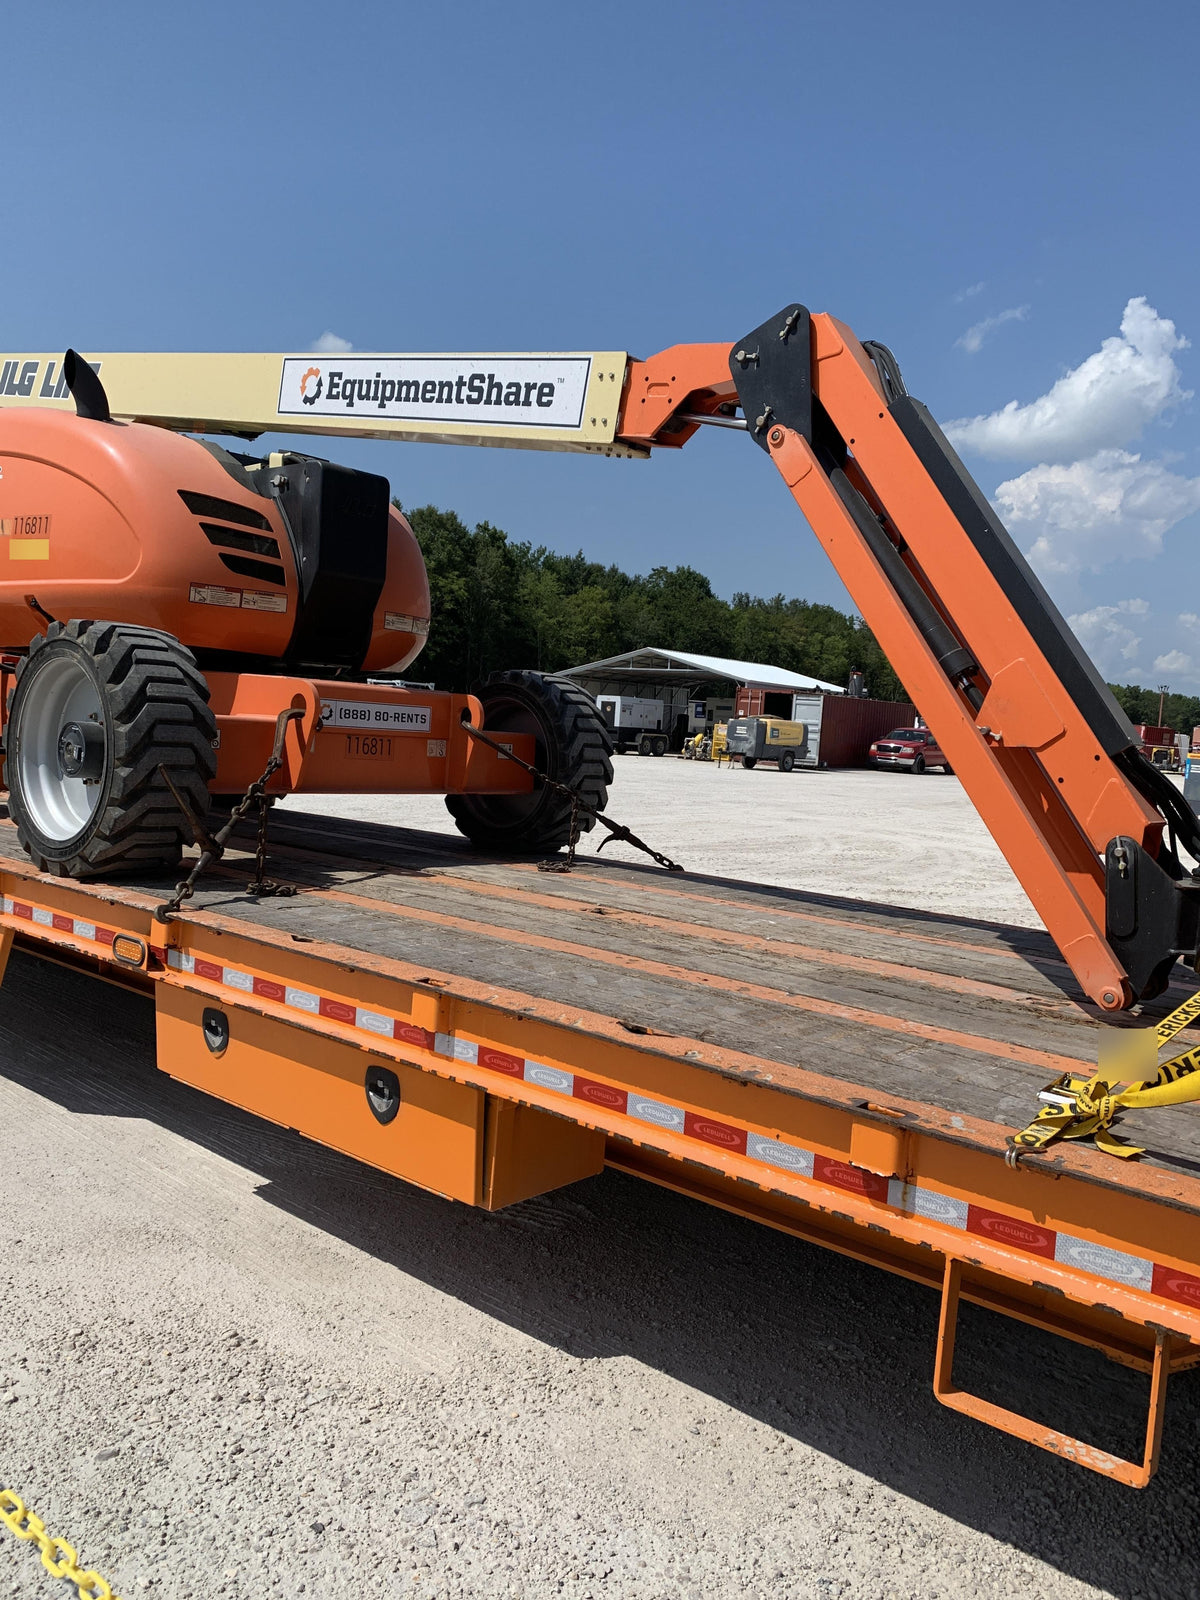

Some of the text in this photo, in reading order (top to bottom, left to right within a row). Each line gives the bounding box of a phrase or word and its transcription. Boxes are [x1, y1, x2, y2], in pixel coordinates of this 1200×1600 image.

[325, 371, 556, 409] EquipmentShare
[14, 516, 49, 535] 116811
[339, 707, 428, 725] (888) 80-RENTS
[346, 735, 392, 756] 116811
[1158, 994, 1200, 1038] ERICKSO
[590, 1088, 616, 1102] LEDWELL
[703, 1126, 732, 1142] LEDWELL
[766, 1147, 803, 1165] LEDWELL
[994, 1222, 1035, 1242] LEDWELL
